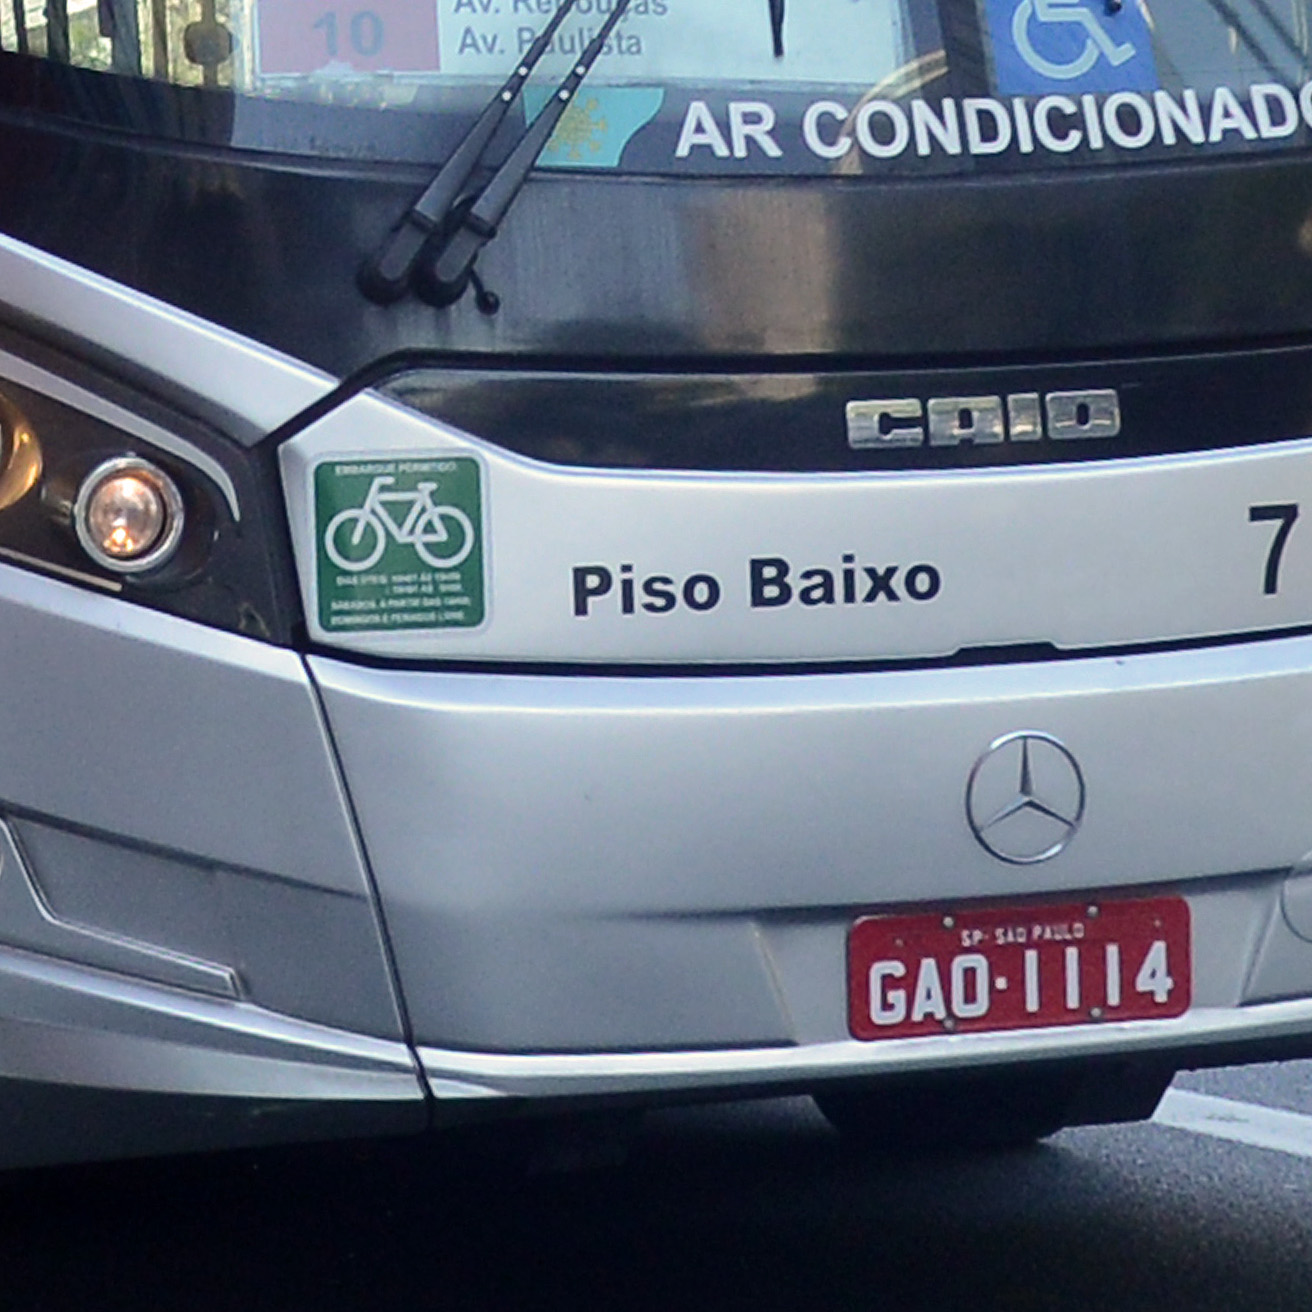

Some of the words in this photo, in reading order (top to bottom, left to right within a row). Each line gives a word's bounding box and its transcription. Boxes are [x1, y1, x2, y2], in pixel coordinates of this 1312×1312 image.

[312, 10, 385, 57] 10
[457, 25, 505, 55] Av.
[675, 100, 784, 159] AR
[845, 389, 1121, 450] CAIO
[1248, 503, 1299, 596] 7
[571, 564, 722, 617] Piso
[749, 554, 941, 608] Baixo
